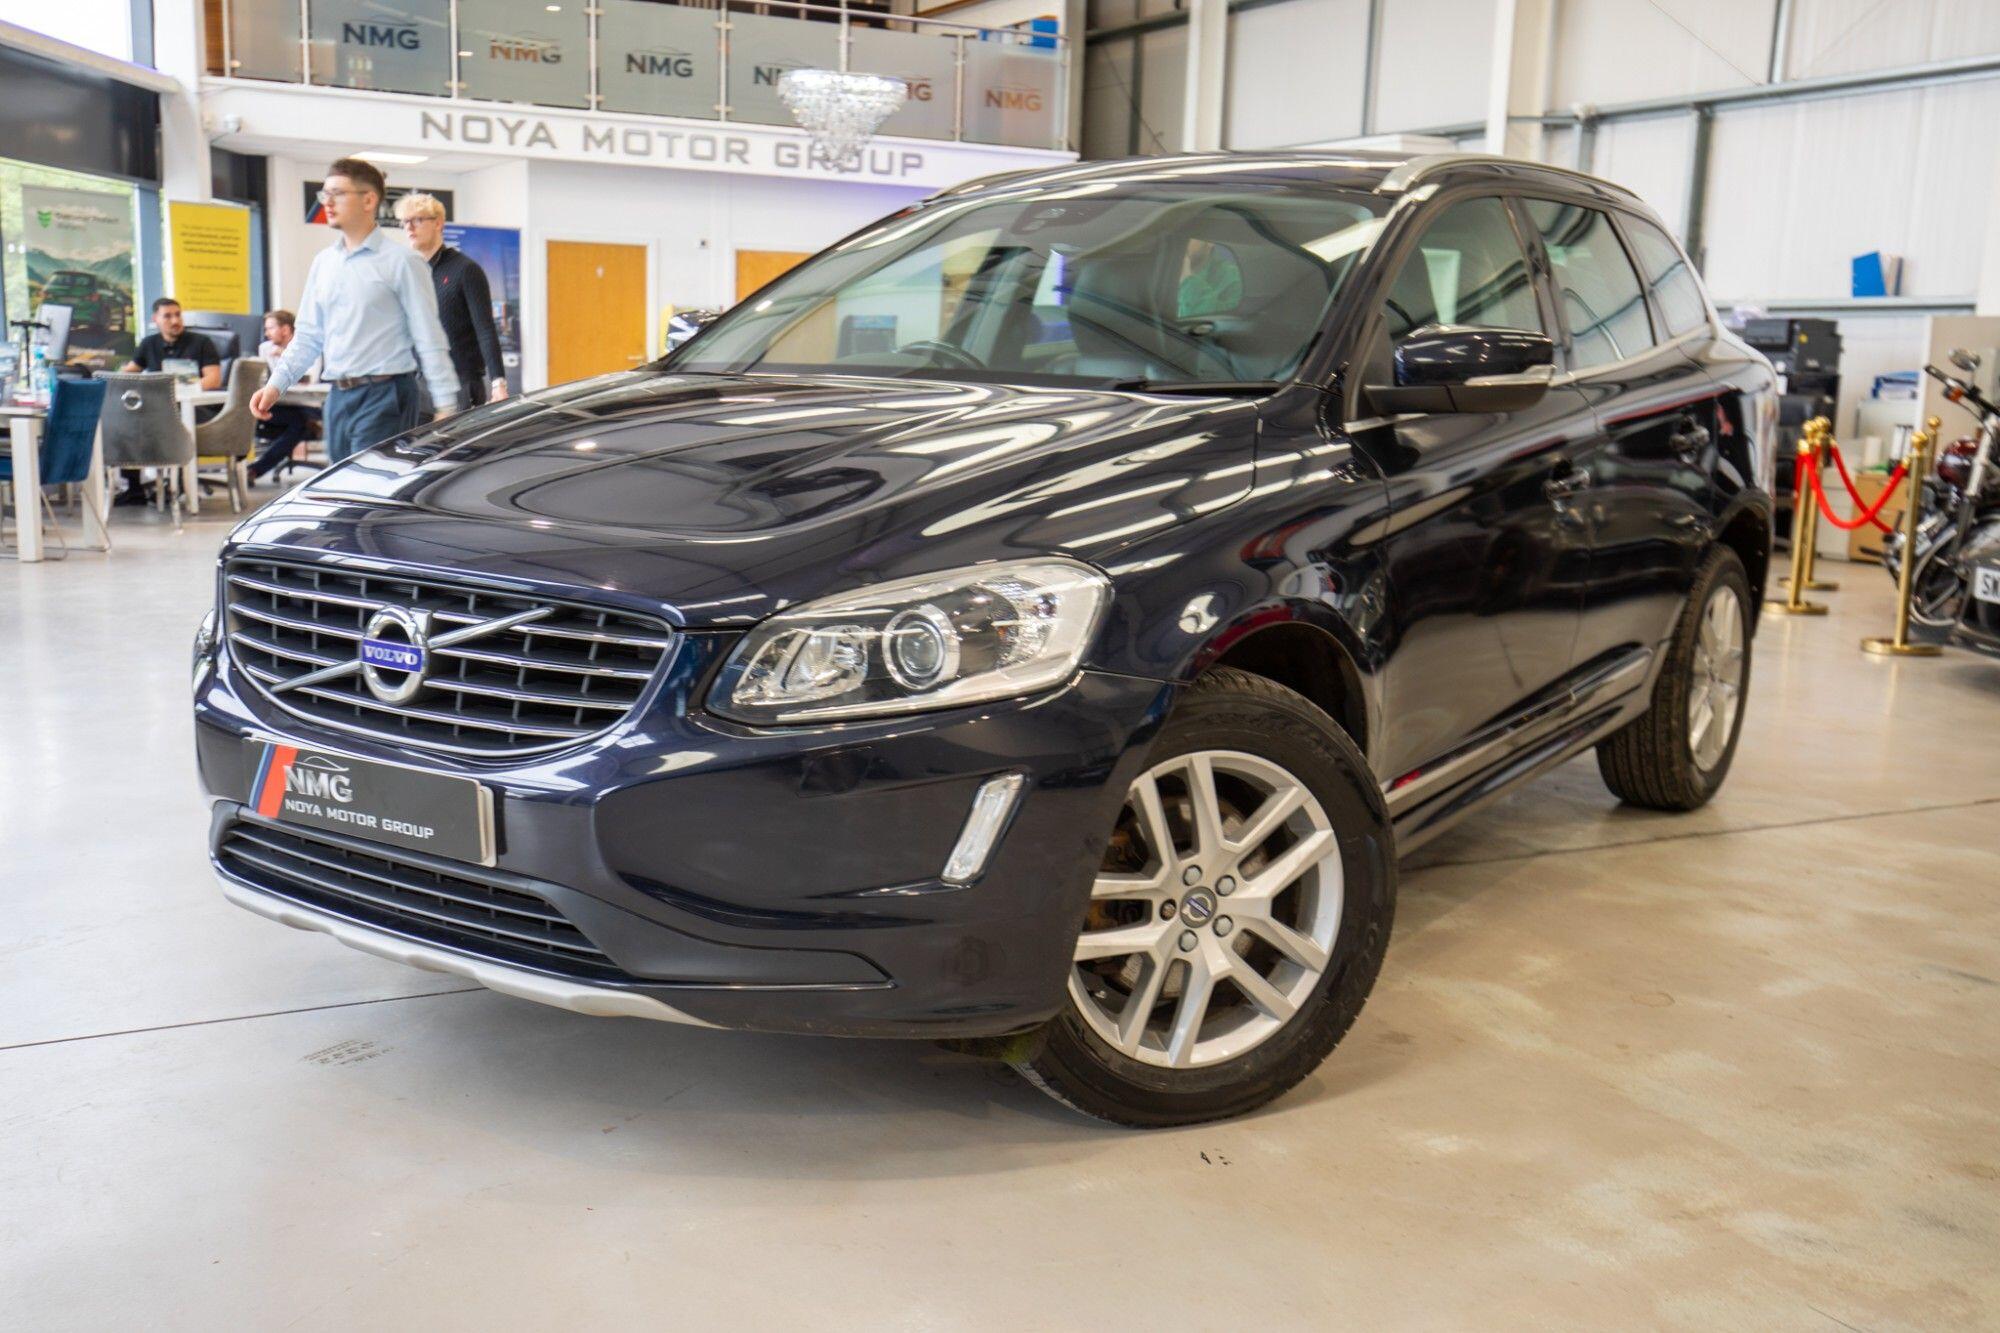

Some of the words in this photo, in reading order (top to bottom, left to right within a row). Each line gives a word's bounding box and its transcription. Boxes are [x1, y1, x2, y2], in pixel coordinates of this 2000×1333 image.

[342, 22, 420, 50] NMG
[489, 38, 562, 64] NMG
[626, 52, 693, 78] NMG
[984, 89, 1042, 112] NMG
[421, 111, 557, 149] NOYA
[582, 124, 749, 164] MOTOR
[363, 645, 418, 666] VOLVO
[283, 765, 353, 803] NMG
[284, 799, 323, 817] NOYA
[326, 807, 378, 828] MOTOR
[381, 818, 435, 839] GROUP
